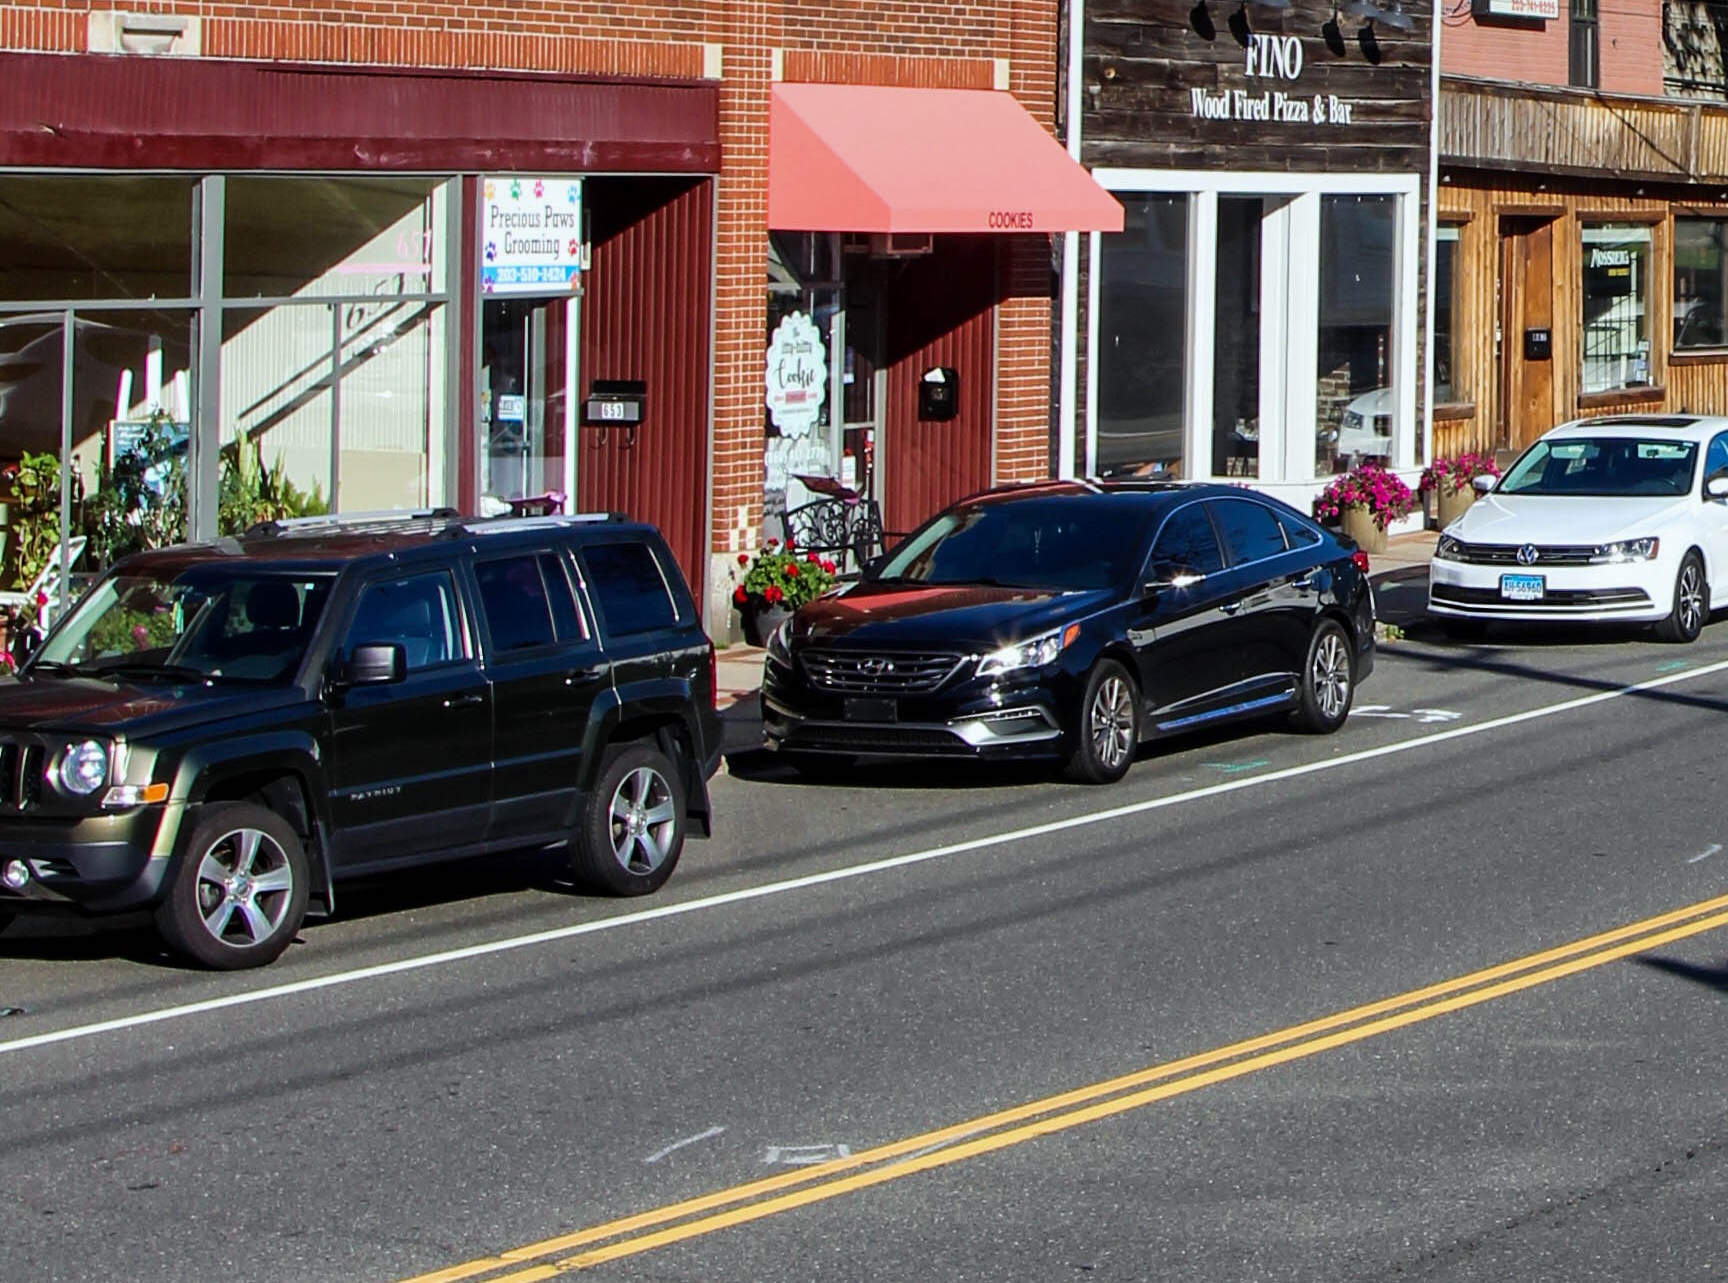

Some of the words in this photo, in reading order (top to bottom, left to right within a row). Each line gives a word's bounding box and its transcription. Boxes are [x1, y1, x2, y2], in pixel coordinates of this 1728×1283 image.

[1244, 34, 1304, 80] FINO
[1191, 87, 1230, 119] Wood
[1233, 89, 1270, 121] Fired
[1274, 91, 1309, 122] Pizza
[1313, 94, 1326, 125] &
[1328, 94, 1353, 125] Bar
[490, 204, 540, 229] Precious
[544, 204, 576, 229] Paws
[988, 211, 1033, 229] COOKIES
[504, 230, 560, 260] Grooming
[774, 357, 816, 390] Cookie
[602, 404, 624, 418] 653
